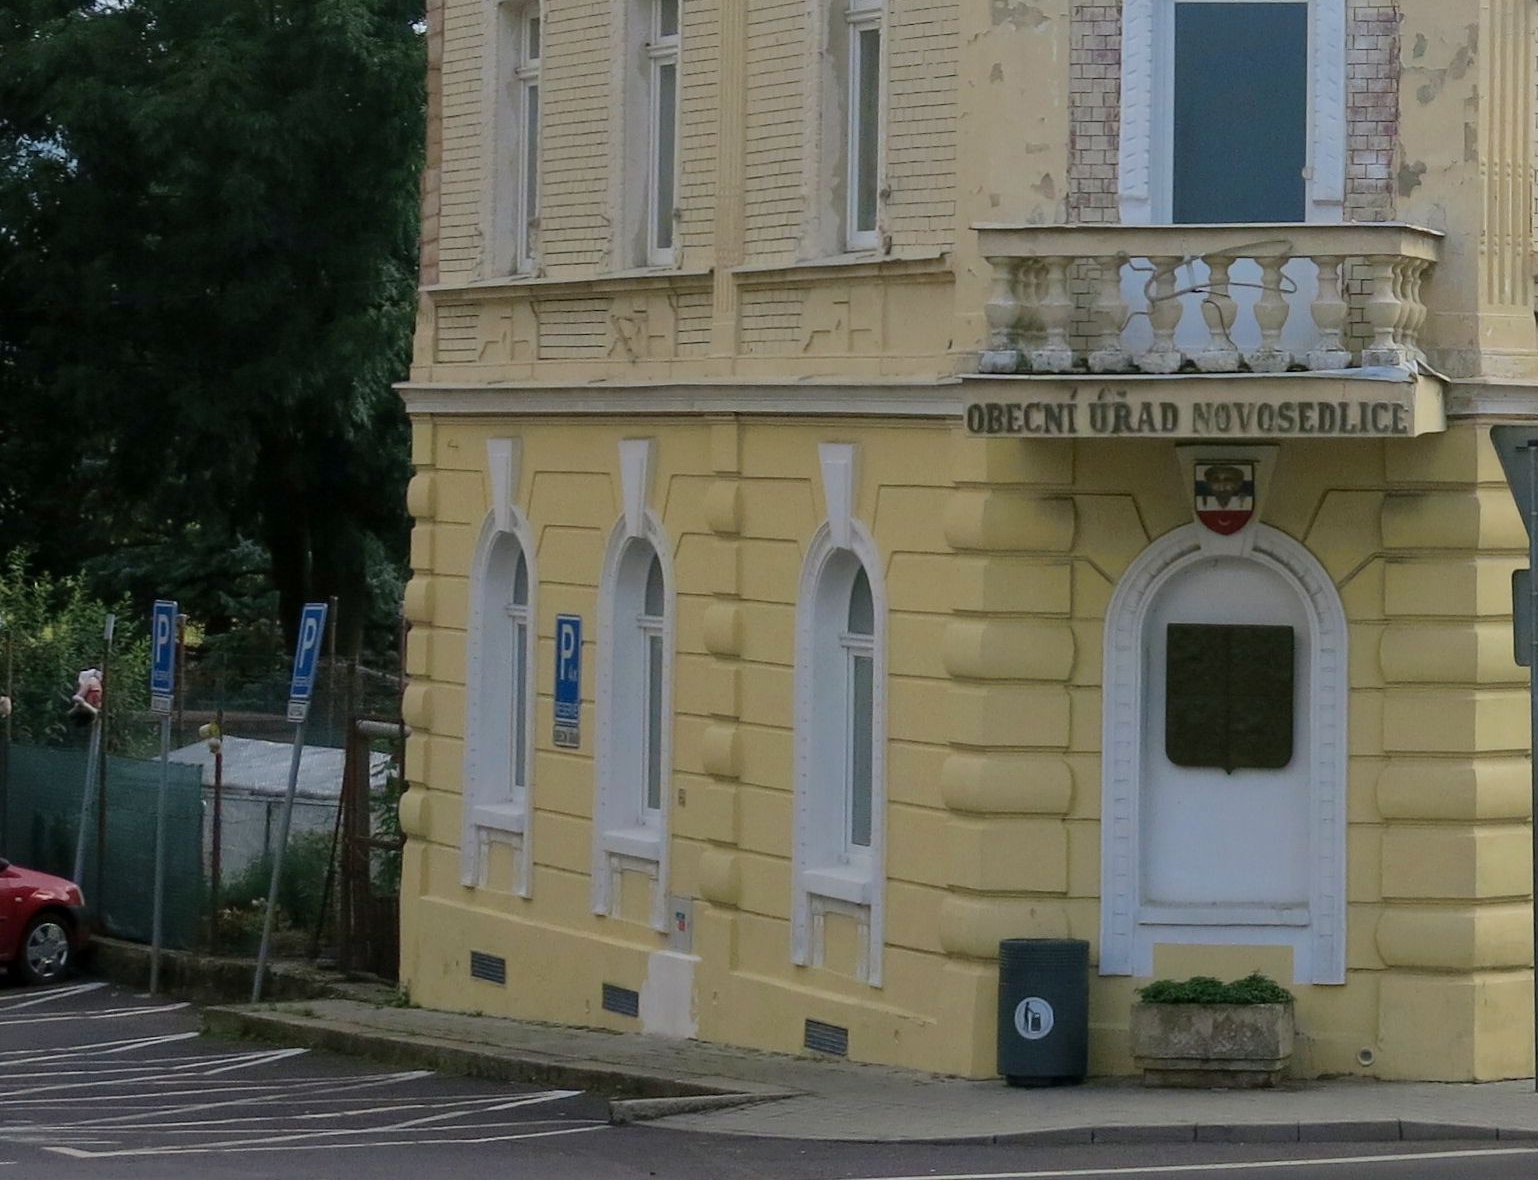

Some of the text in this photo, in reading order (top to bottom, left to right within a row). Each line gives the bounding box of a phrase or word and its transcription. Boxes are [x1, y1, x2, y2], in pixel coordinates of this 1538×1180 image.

[967, 387, 1078, 434] OBECNÍ
[1192, 401, 1409, 434] NOVOSEDLICE
[157, 614, 170, 662] P
[299, 617, 317, 669] P
[561, 623, 575, 680] P
